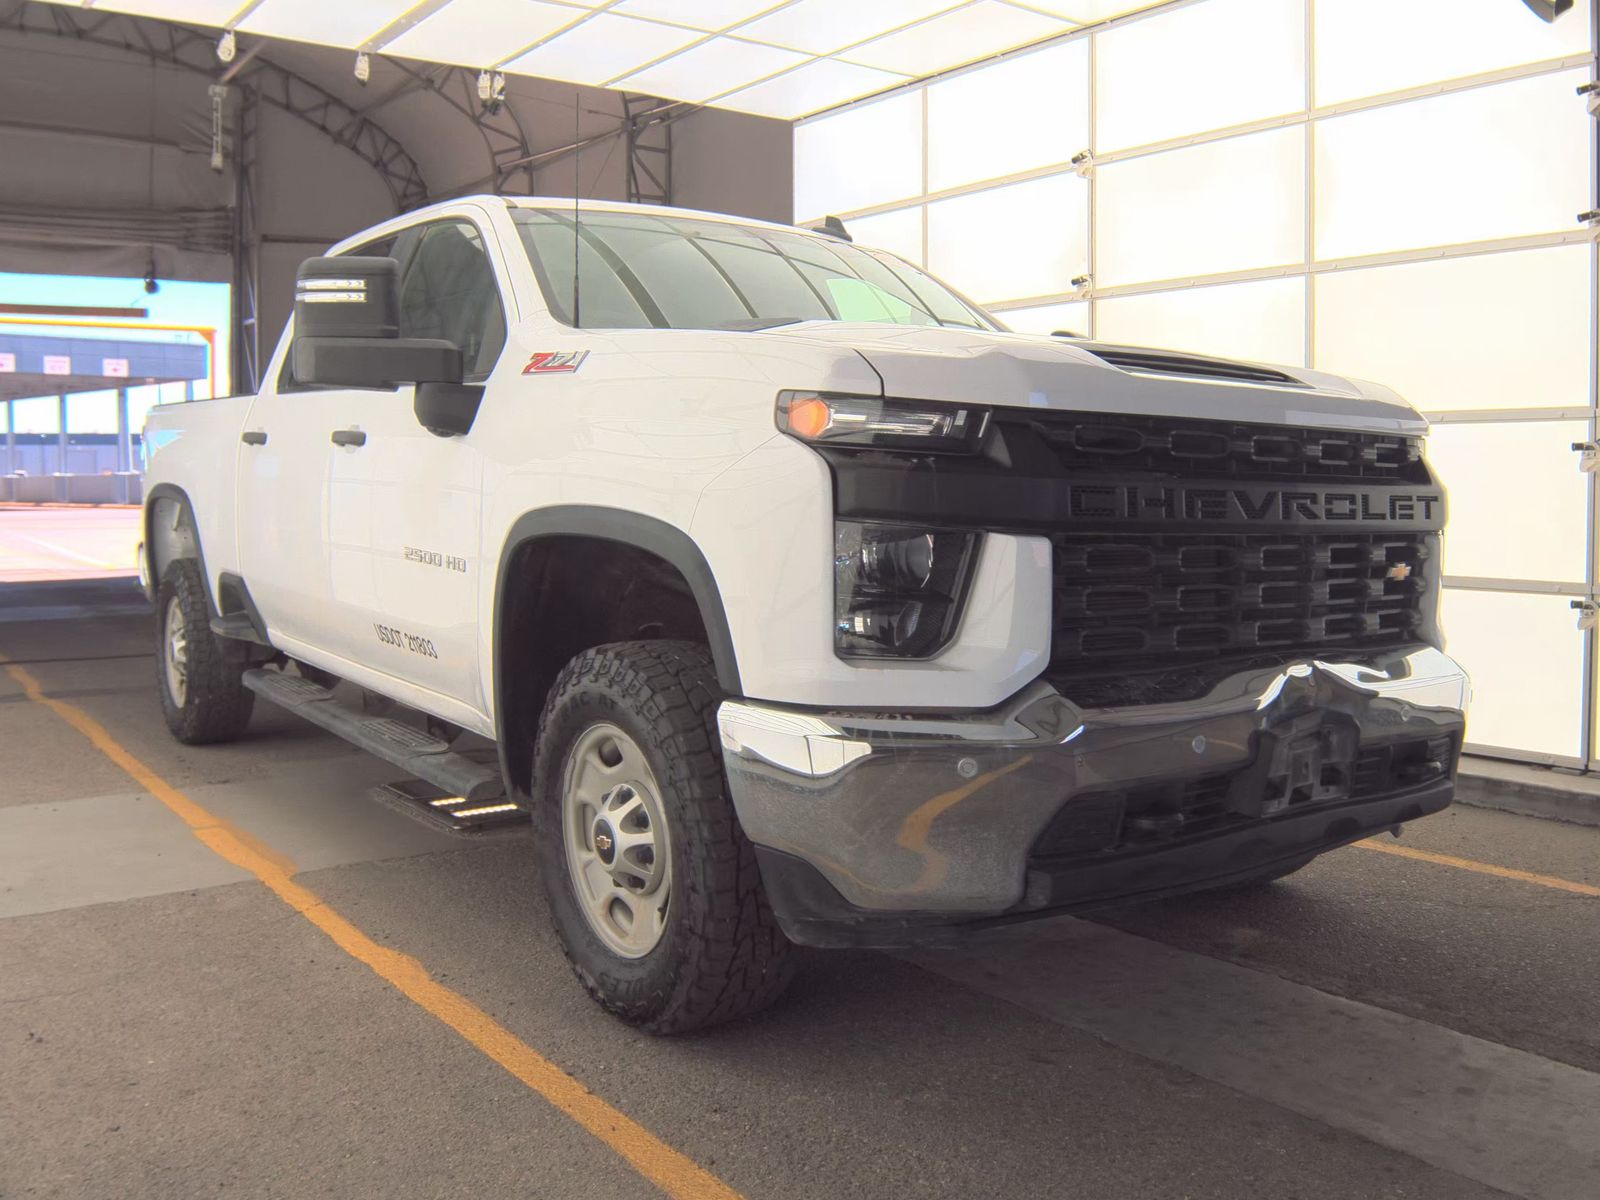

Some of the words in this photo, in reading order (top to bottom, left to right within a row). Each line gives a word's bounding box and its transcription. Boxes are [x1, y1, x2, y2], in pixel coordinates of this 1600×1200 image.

[521, 349, 591, 375] Z71
[1068, 484, 1440, 521] CHEVROLET
[404, 546, 443, 568] 2500
[446, 553, 467, 573] HD
[373, 623, 405, 649] USDOT
[404, 632, 438, 659] 211803
